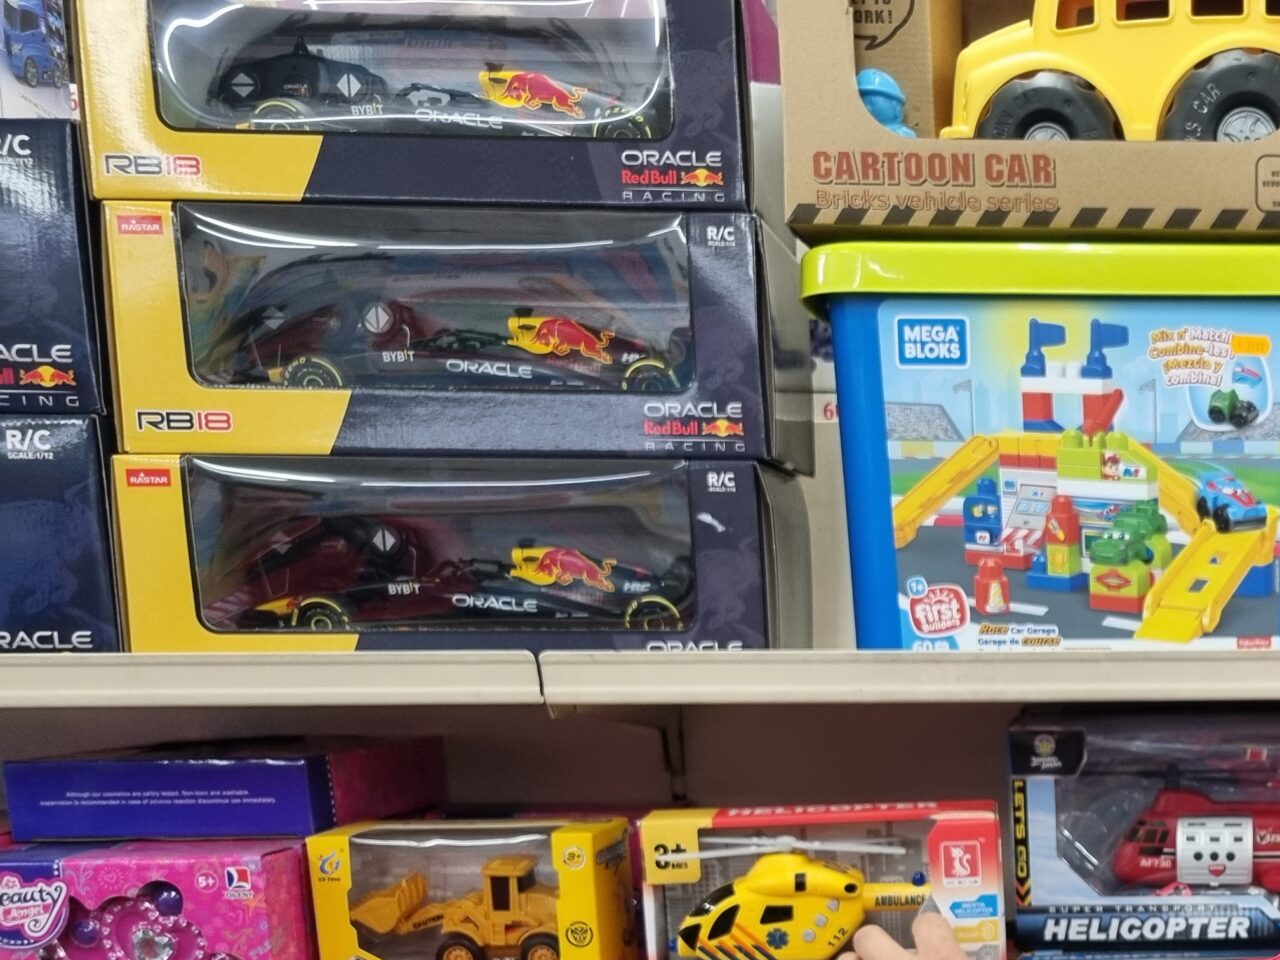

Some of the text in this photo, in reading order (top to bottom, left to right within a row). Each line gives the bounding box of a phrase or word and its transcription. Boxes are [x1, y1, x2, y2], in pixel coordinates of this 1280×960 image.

[351, 103, 384, 116] BYBIT
[415, 108, 504, 130] ORACLE
[0, 133, 31, 156] /C
[103, 154, 202, 177] RB18
[621, 150, 723, 167] ORACLE
[812, 150, 1057, 188] CARTOON CAR
[621, 191, 725, 202] RACING
[815, 189, 1059, 212] Bricks vehicle series
[120, 221, 161, 232] RASTAR
[706, 226, 735, 241] R/C
[904, 326, 960, 342] MEGA
[382, 350, 415, 363] BYBIT
[904, 343, 961, 360] BLOKS
[445, 358, 534, 380] ORACLE
[643, 401, 743, 419] ORACLE
[136, 410, 233, 432] RB18
[6, 430, 51, 451] R/C
[644, 442, 746, 453] RACING
[130, 473, 169, 485] RASTAR
[706, 471, 736, 488] R/C
[388, 580, 421, 595] BYBIT
[452, 593, 538, 613] ORACLE
[915, 599, 961, 625] first
[727, 801, 938, 816] HELICOPTER
[1015, 842, 1028, 878] GO
[874, 894, 927, 909] AMBULANCE
[1049, 904, 1104, 913] SUPER
[1043, 916, 1250, 942] HELICOPTER
[826, 927, 848, 951] 112
